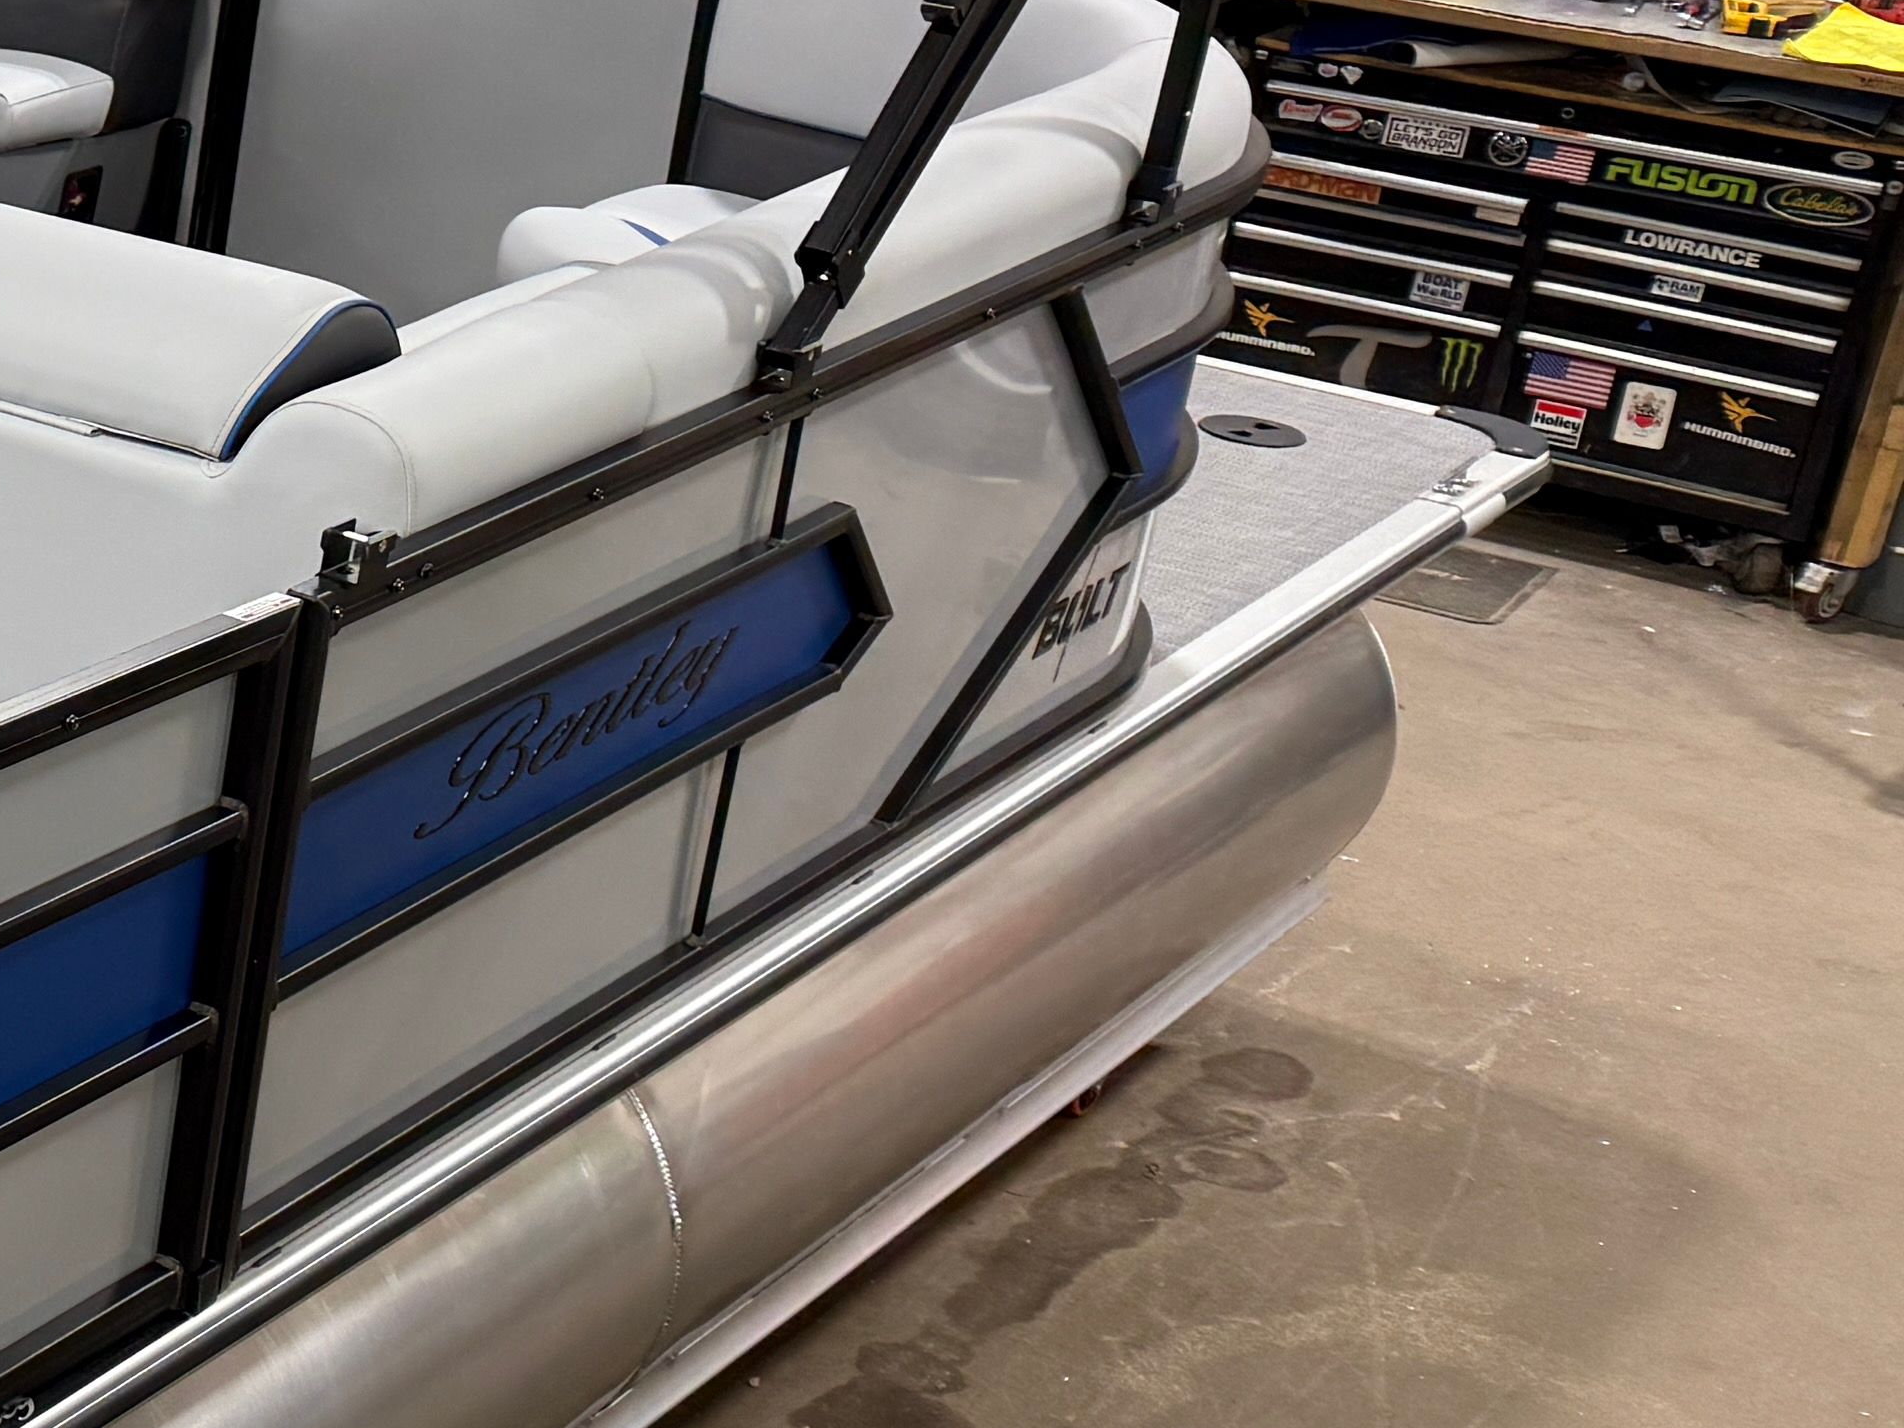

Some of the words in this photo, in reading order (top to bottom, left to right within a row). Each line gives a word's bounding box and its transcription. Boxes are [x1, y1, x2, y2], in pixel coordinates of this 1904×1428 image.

[1392, 132, 1458, 151] BRANDON
[1393, 122, 1434, 137] LET'S
[1438, 129, 1461, 141] GO
[1603, 156, 1759, 205] FUSION
[1778, 187, 1861, 218] Cabela's
[1623, 228, 1763, 269] LOWRANCE
[1421, 272, 1462, 290] BOAT
[1669, 281, 1702, 294] RAM
[1534, 411, 1580, 434] Holley
[412, 620, 741, 840] Bentley
